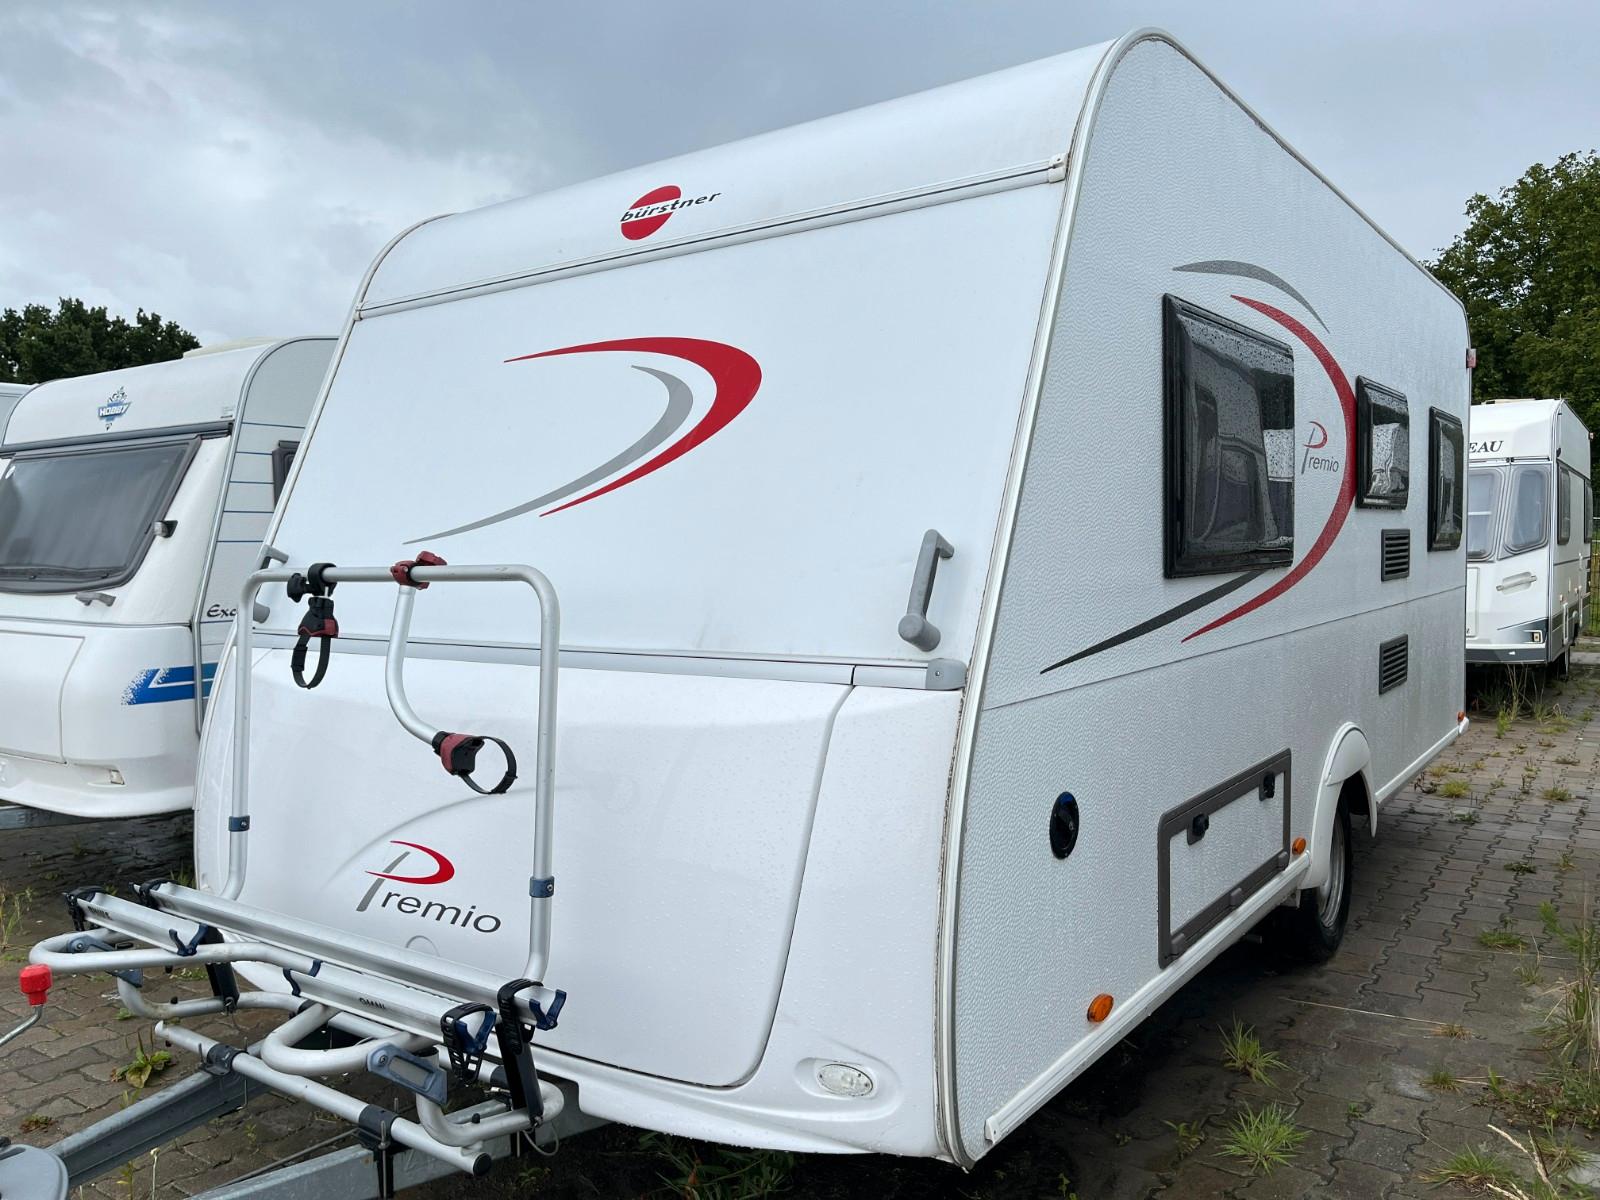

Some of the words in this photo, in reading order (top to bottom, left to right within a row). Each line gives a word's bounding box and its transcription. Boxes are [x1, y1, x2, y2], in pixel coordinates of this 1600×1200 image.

[620, 192, 721, 223] bürstner
[1301, 421, 1339, 475] Premio
[1469, 440, 1504, 453] EAU
[356, 840, 501, 933] Premio
